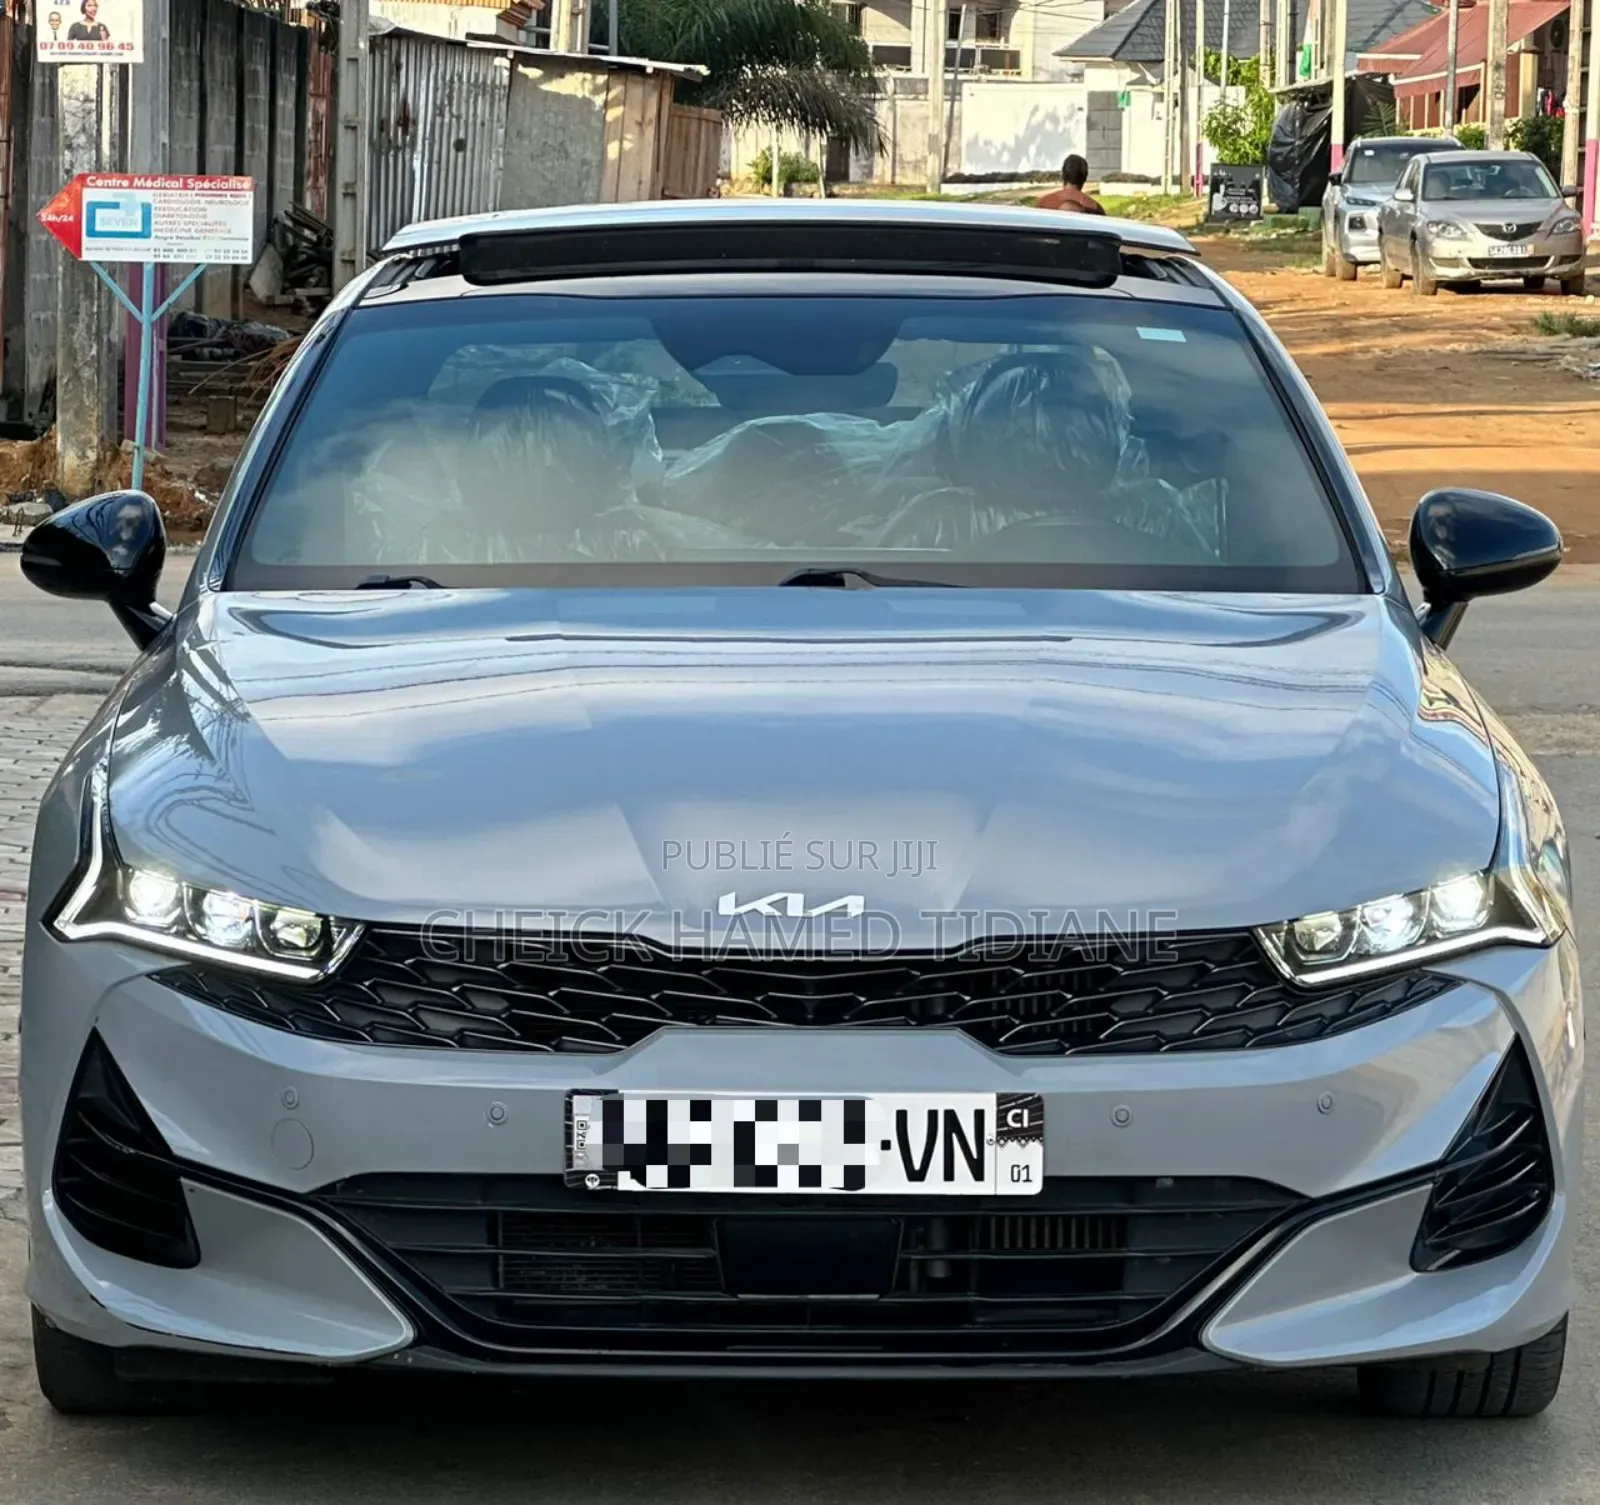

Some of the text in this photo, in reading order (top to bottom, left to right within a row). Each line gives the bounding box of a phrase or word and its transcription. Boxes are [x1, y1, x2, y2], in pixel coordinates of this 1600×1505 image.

[86, 175, 250, 191] Centre Médical Spécialisé
[718, 891, 865, 919] KIA
[1006, 1109, 1029, 1127] CI
[1010, 1164, 1033, 1182] 01
